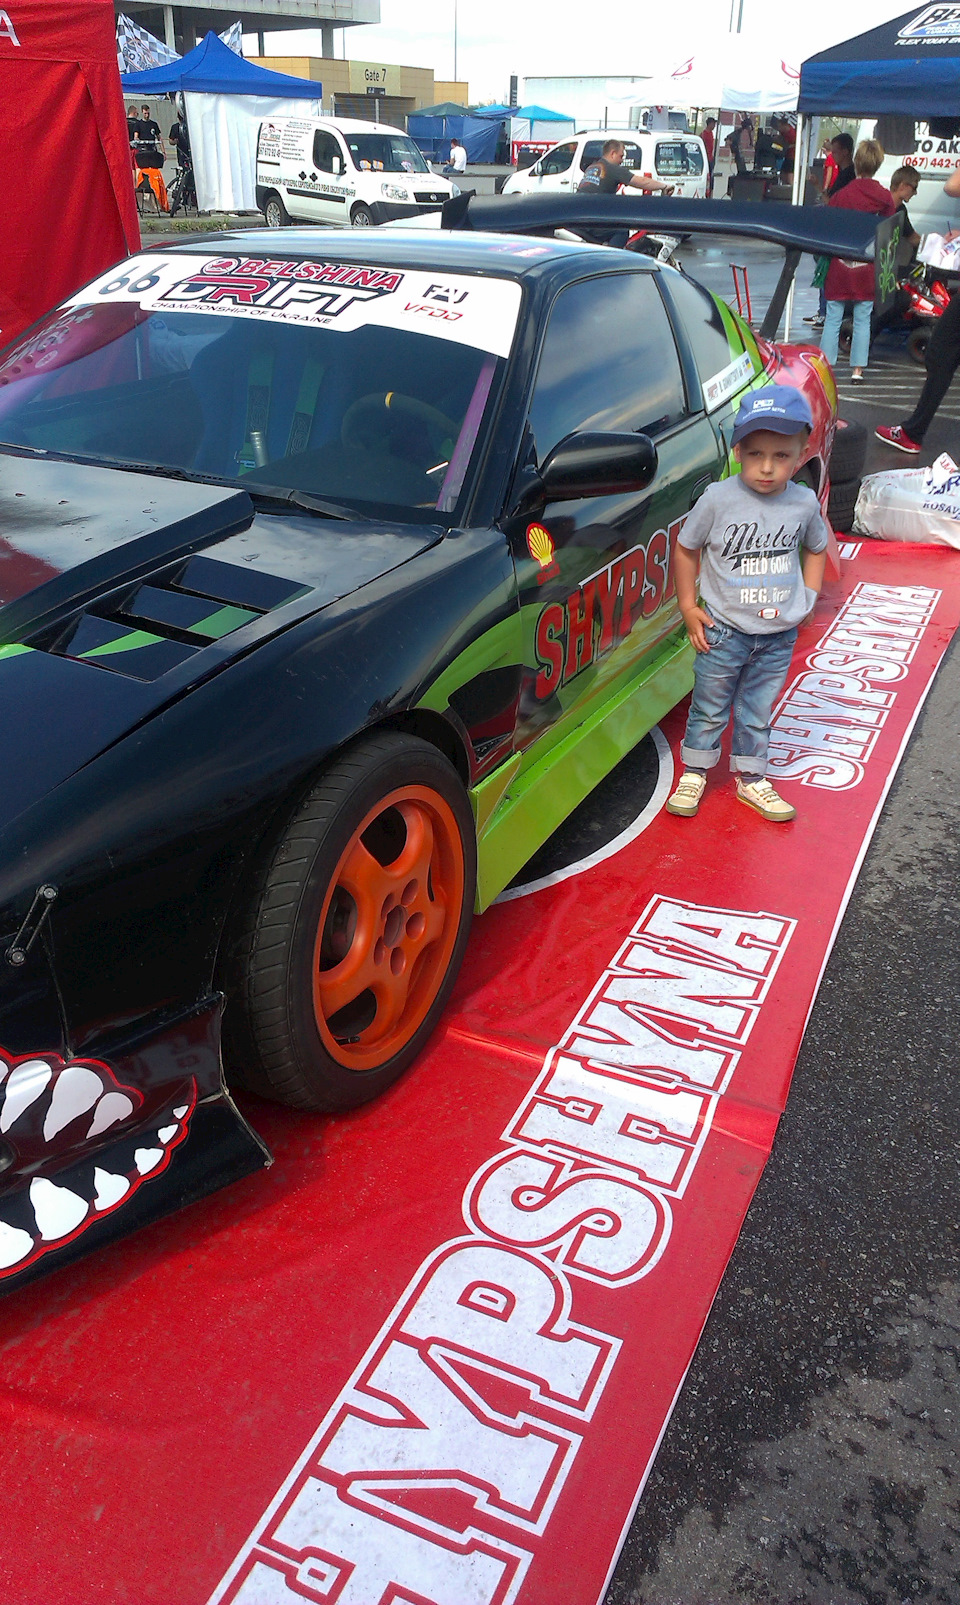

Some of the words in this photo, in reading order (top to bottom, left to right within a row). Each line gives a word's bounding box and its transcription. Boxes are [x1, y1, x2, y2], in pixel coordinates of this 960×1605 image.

[921, 37, 950, 45] YOUR
[364, 68, 380, 81] Gate
[381, 67, 387, 82] 7
[98, 262, 169, 295] 66
[231, 258, 402, 294] BELSHINA
[158, 273, 394, 318] DRIFT
[151, 302, 247, 314] CHAMPIONSHIP
[250, 308, 269, 317] OF
[271, 310, 332, 325] UKRAINE
[536, 563, 561, 585] Shell
[740, 555, 768, 576] FIELD
[740, 588, 771, 604] REG.
